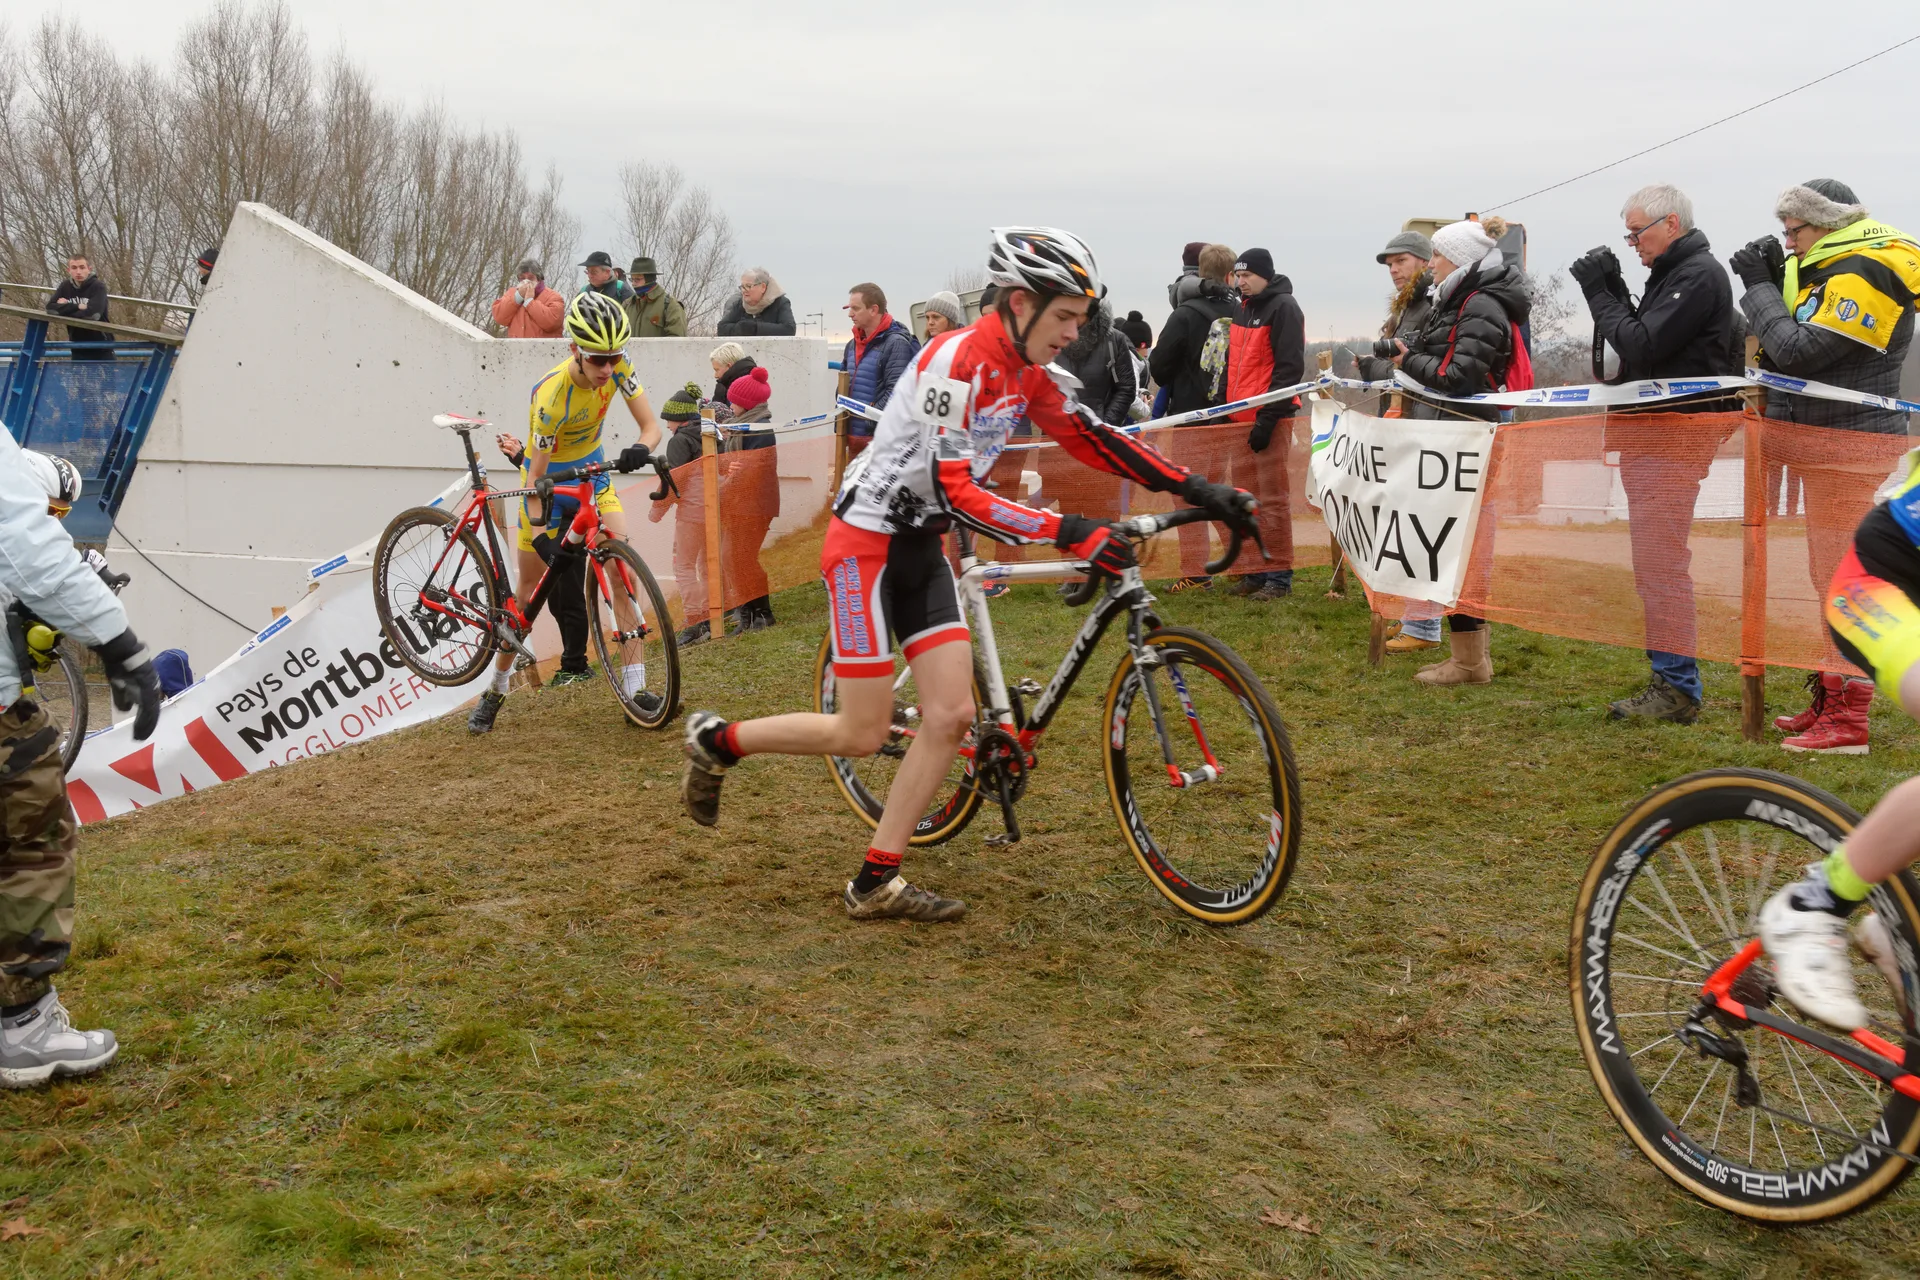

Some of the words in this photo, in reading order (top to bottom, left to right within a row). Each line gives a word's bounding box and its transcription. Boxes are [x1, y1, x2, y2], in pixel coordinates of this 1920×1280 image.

[923, 387, 952, 417] 88
[1418, 449, 1479, 493] DE
[216, 672, 285, 723] Pays
[283, 644, 321, 678] de
[1586, 874, 1629, 1055] MAXWHEEL
[1706, 1158, 1729, 1185] 50B
[1730, 1127, 1892, 1199] MAXWHEEL
